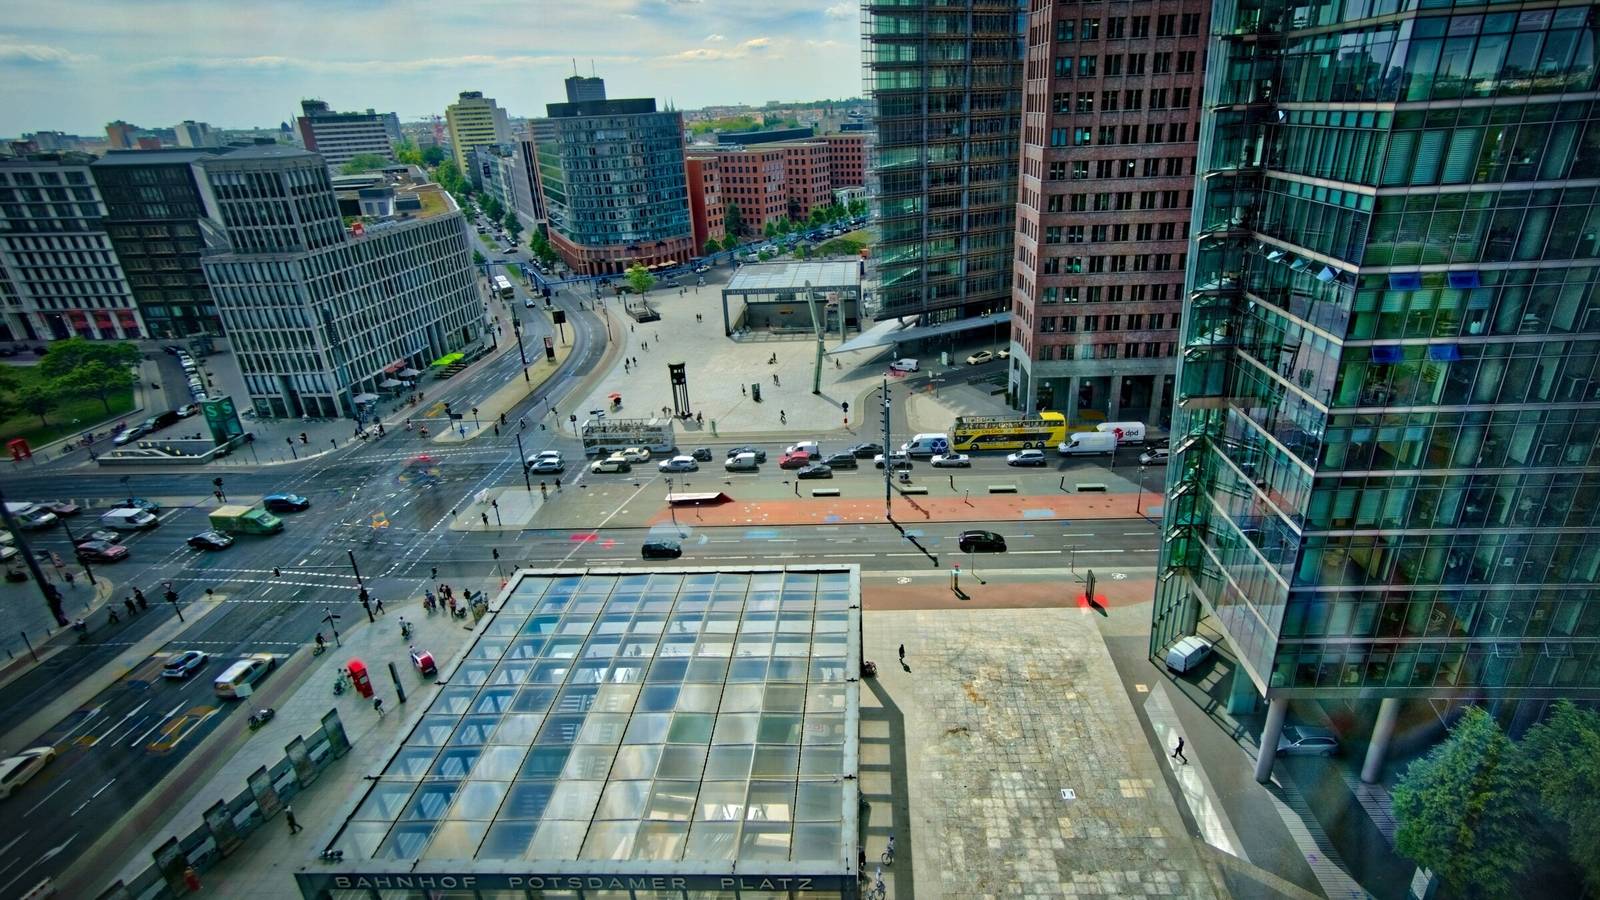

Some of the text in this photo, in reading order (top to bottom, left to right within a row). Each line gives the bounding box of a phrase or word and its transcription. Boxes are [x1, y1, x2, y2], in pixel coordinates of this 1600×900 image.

[206, 405, 217, 417] S
[222, 401, 233, 414] S
[1125, 429, 1139, 437] dpd
[335, 876, 814, 890] BAHNHOF POTSDAMER PLATZ
